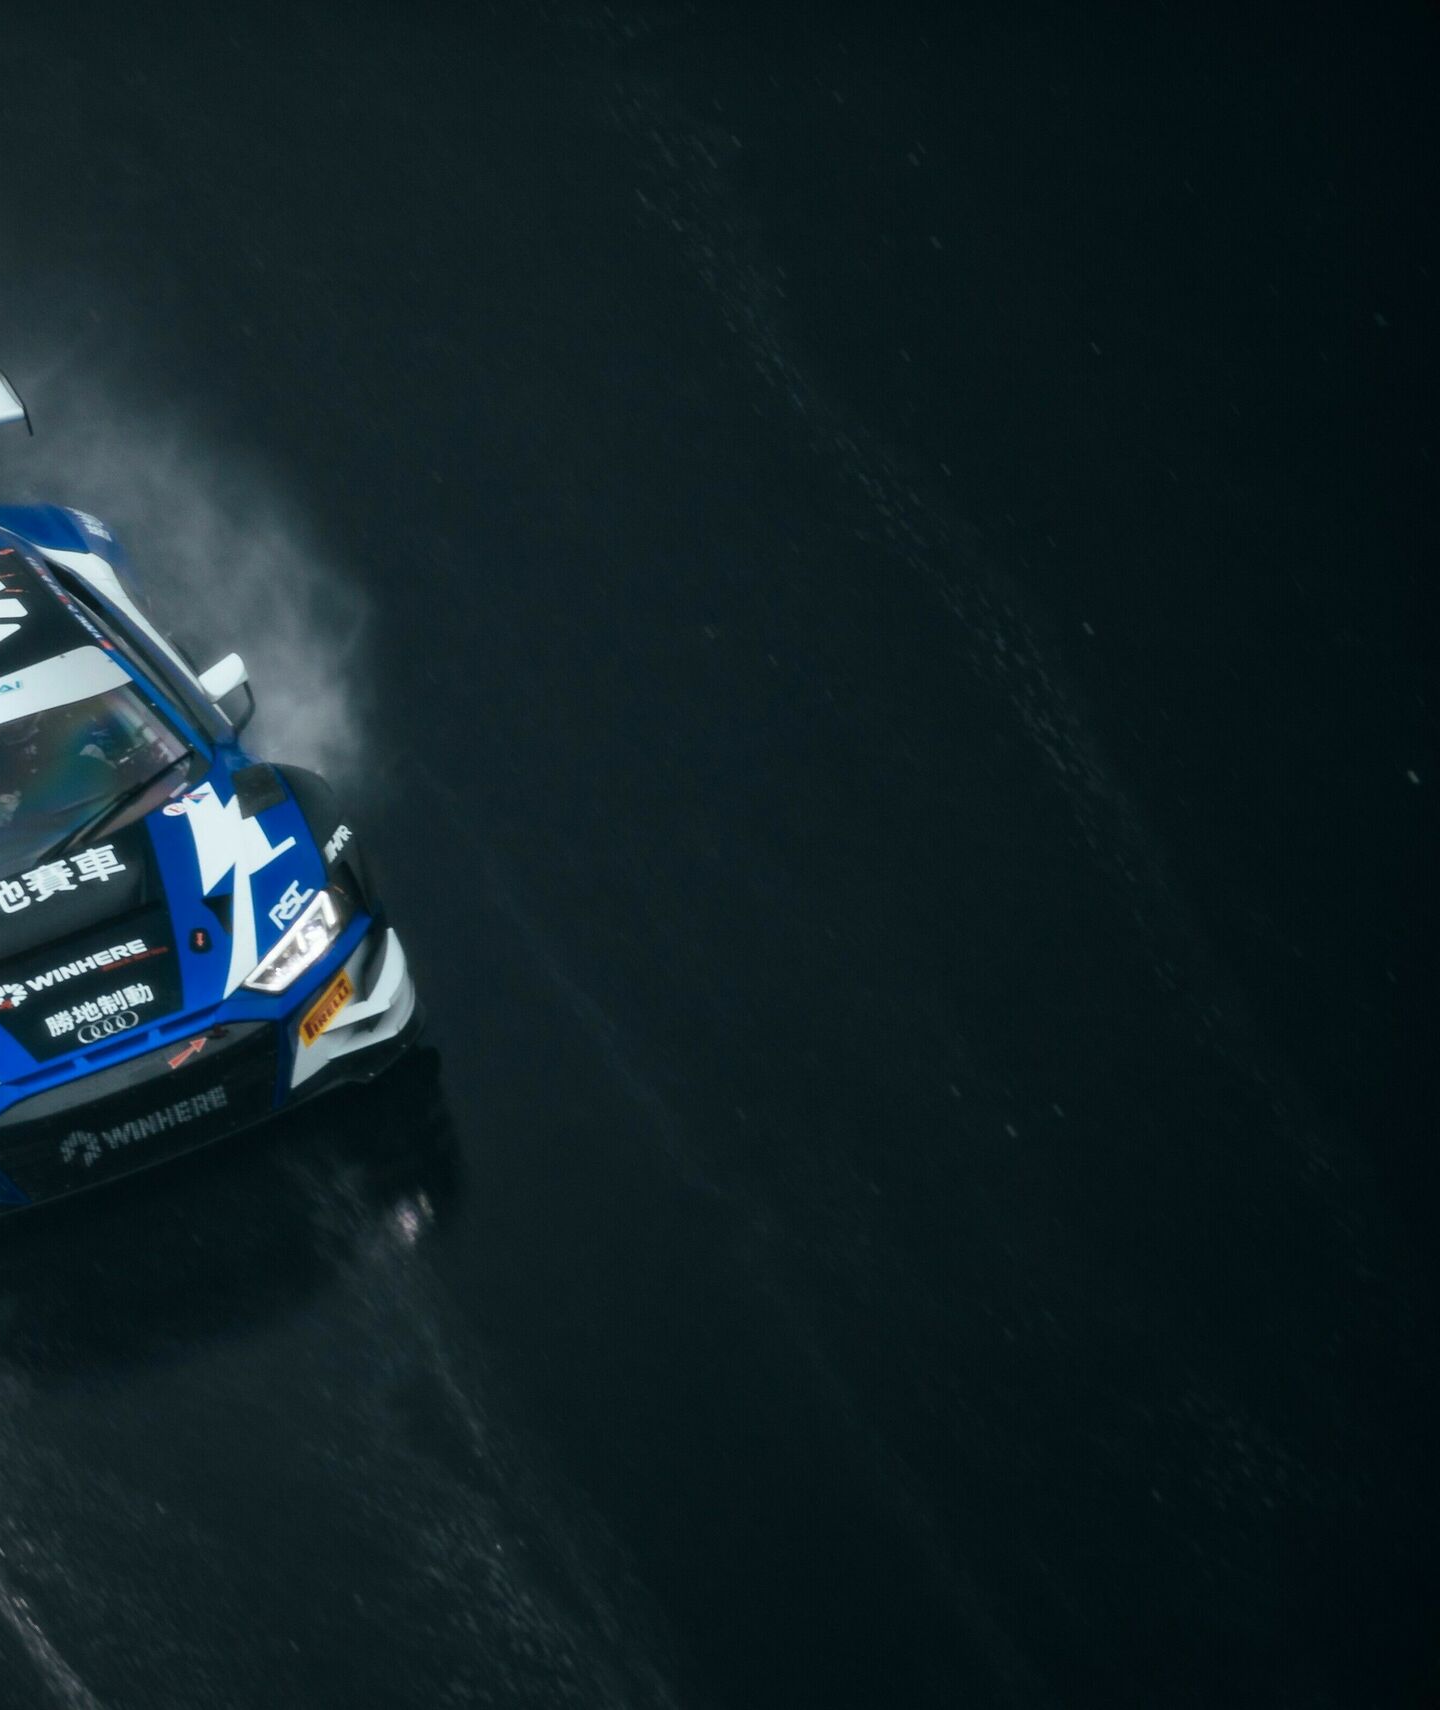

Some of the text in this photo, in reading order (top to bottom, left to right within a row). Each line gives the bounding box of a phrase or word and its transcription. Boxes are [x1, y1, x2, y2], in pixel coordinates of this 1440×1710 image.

[25, 938, 148, 992] WINHERE
[303, 978, 350, 1040] PIRELLI
[100, 1085, 228, 1150] WINHERE
